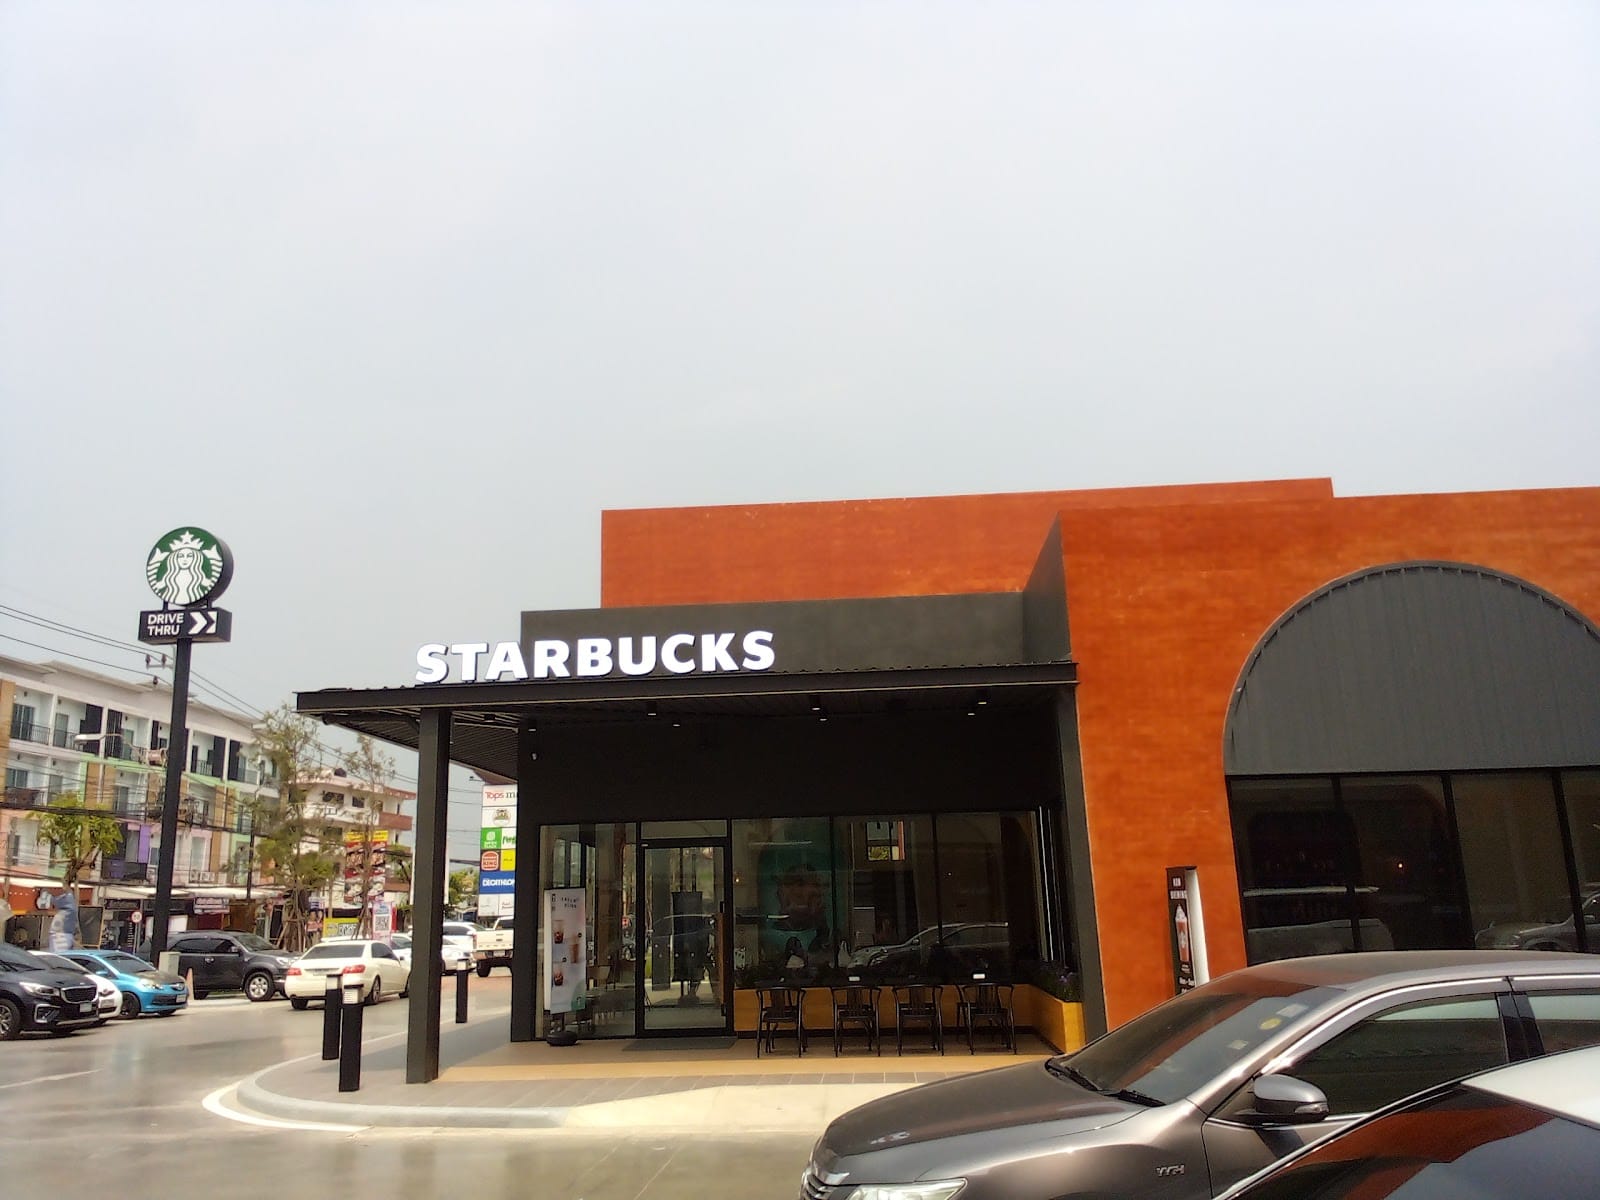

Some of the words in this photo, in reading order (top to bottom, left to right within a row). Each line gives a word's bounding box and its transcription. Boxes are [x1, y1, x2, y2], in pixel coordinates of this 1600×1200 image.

[147, 612, 185, 625] DRIVE
[147, 624, 180, 636] THRU
[415, 631, 775, 684] STARBUCKS
[486, 792, 504, 801] Tops
